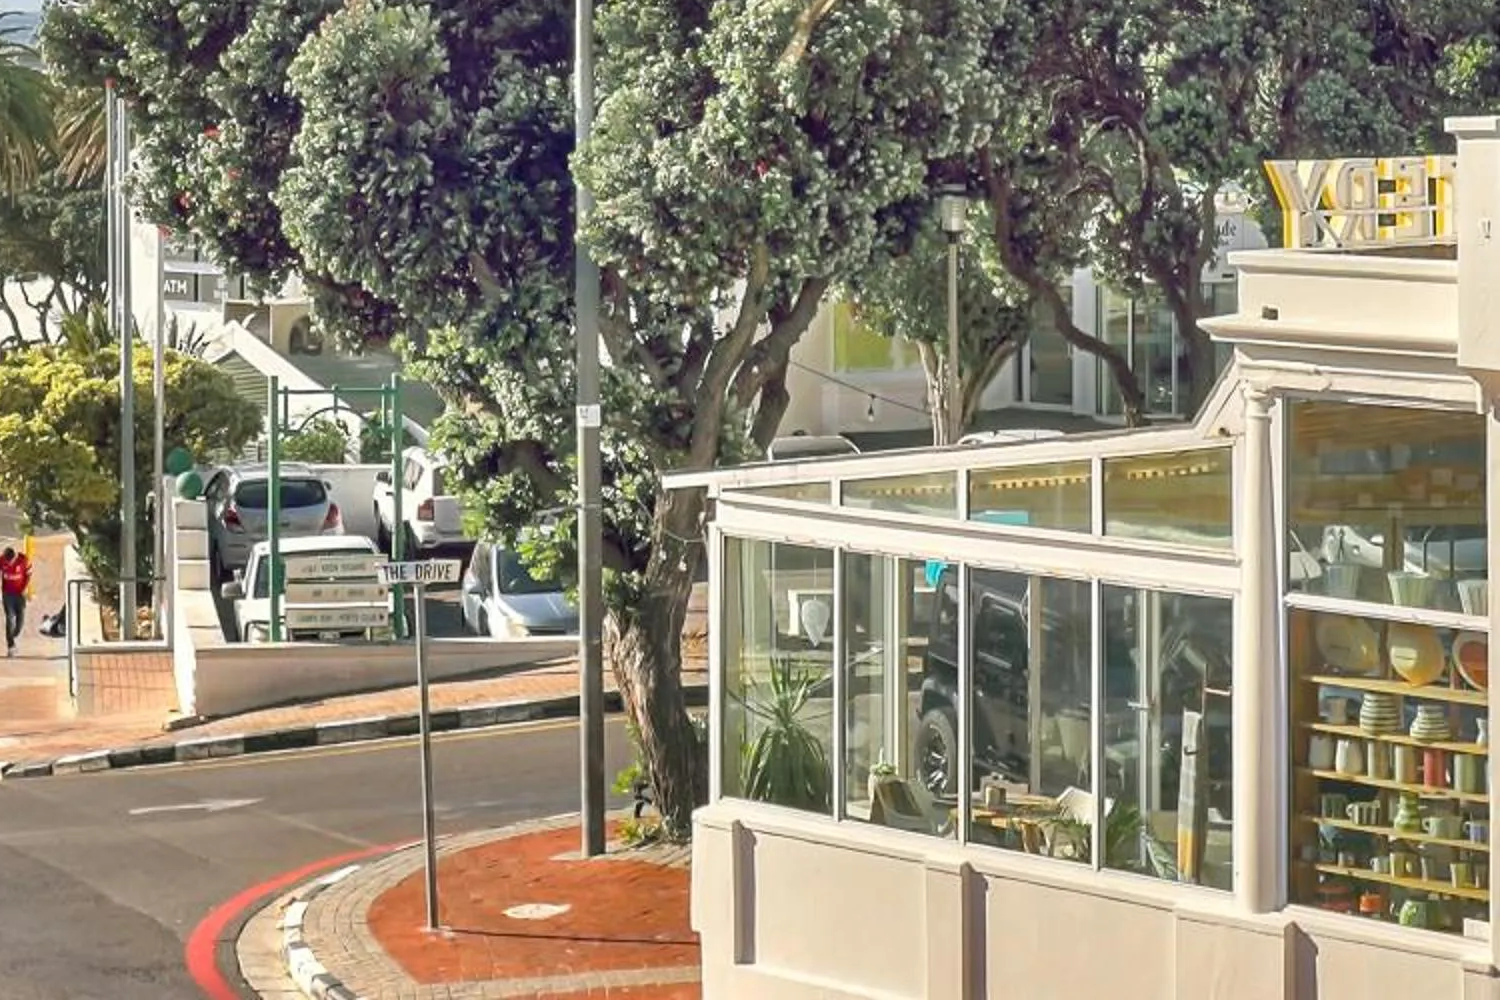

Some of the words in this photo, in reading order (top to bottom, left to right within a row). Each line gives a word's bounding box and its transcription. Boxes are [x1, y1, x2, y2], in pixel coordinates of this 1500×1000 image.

[164, 279, 187, 294] ATM
[382, 564, 408, 581] THE
[415, 563, 453, 580] DRIVE
